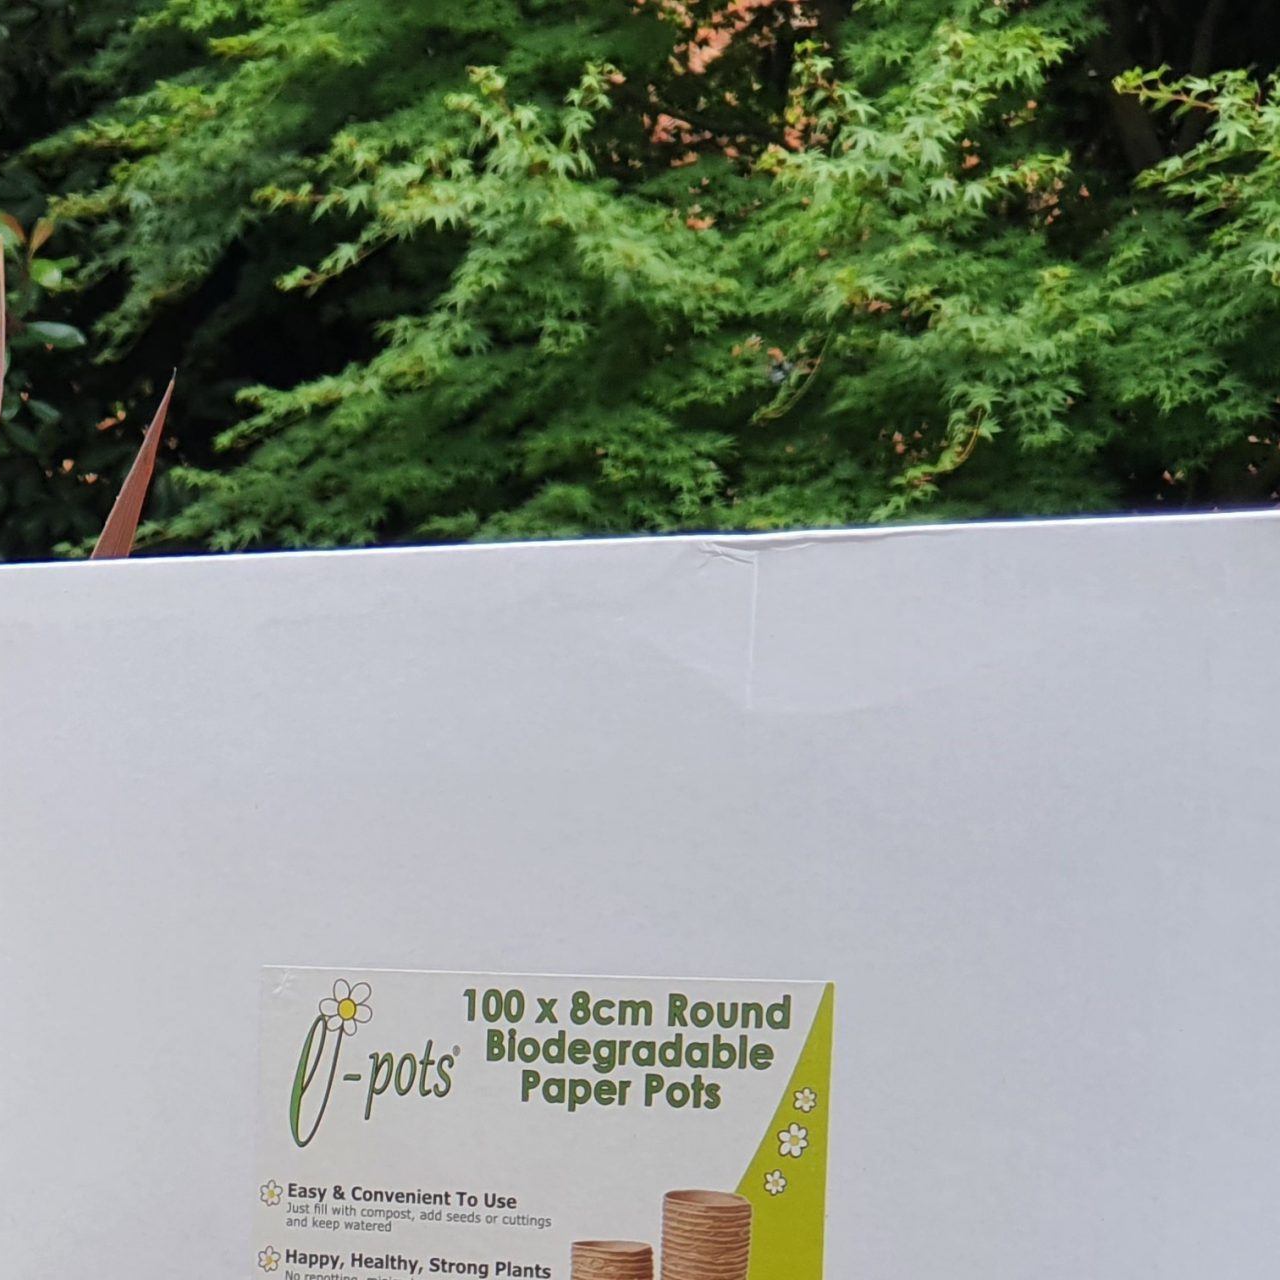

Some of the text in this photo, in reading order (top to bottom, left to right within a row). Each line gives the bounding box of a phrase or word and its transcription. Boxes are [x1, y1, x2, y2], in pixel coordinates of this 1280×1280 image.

[462, 988, 791, 1030] 100 x 8cm Round
[486, 1028, 774, 1076] Biodegradable
[521, 1069, 721, 1112] Paper Pots
[287, 1182, 517, 1209] Easy & Convenient To Use
[285, 1203, 552, 1228] Just fill with compost, add seeds or cuttings
[285, 1216, 392, 1232] and keep watered
[285, 1248, 551, 1279] Happy, Healthy, Strong Plants
